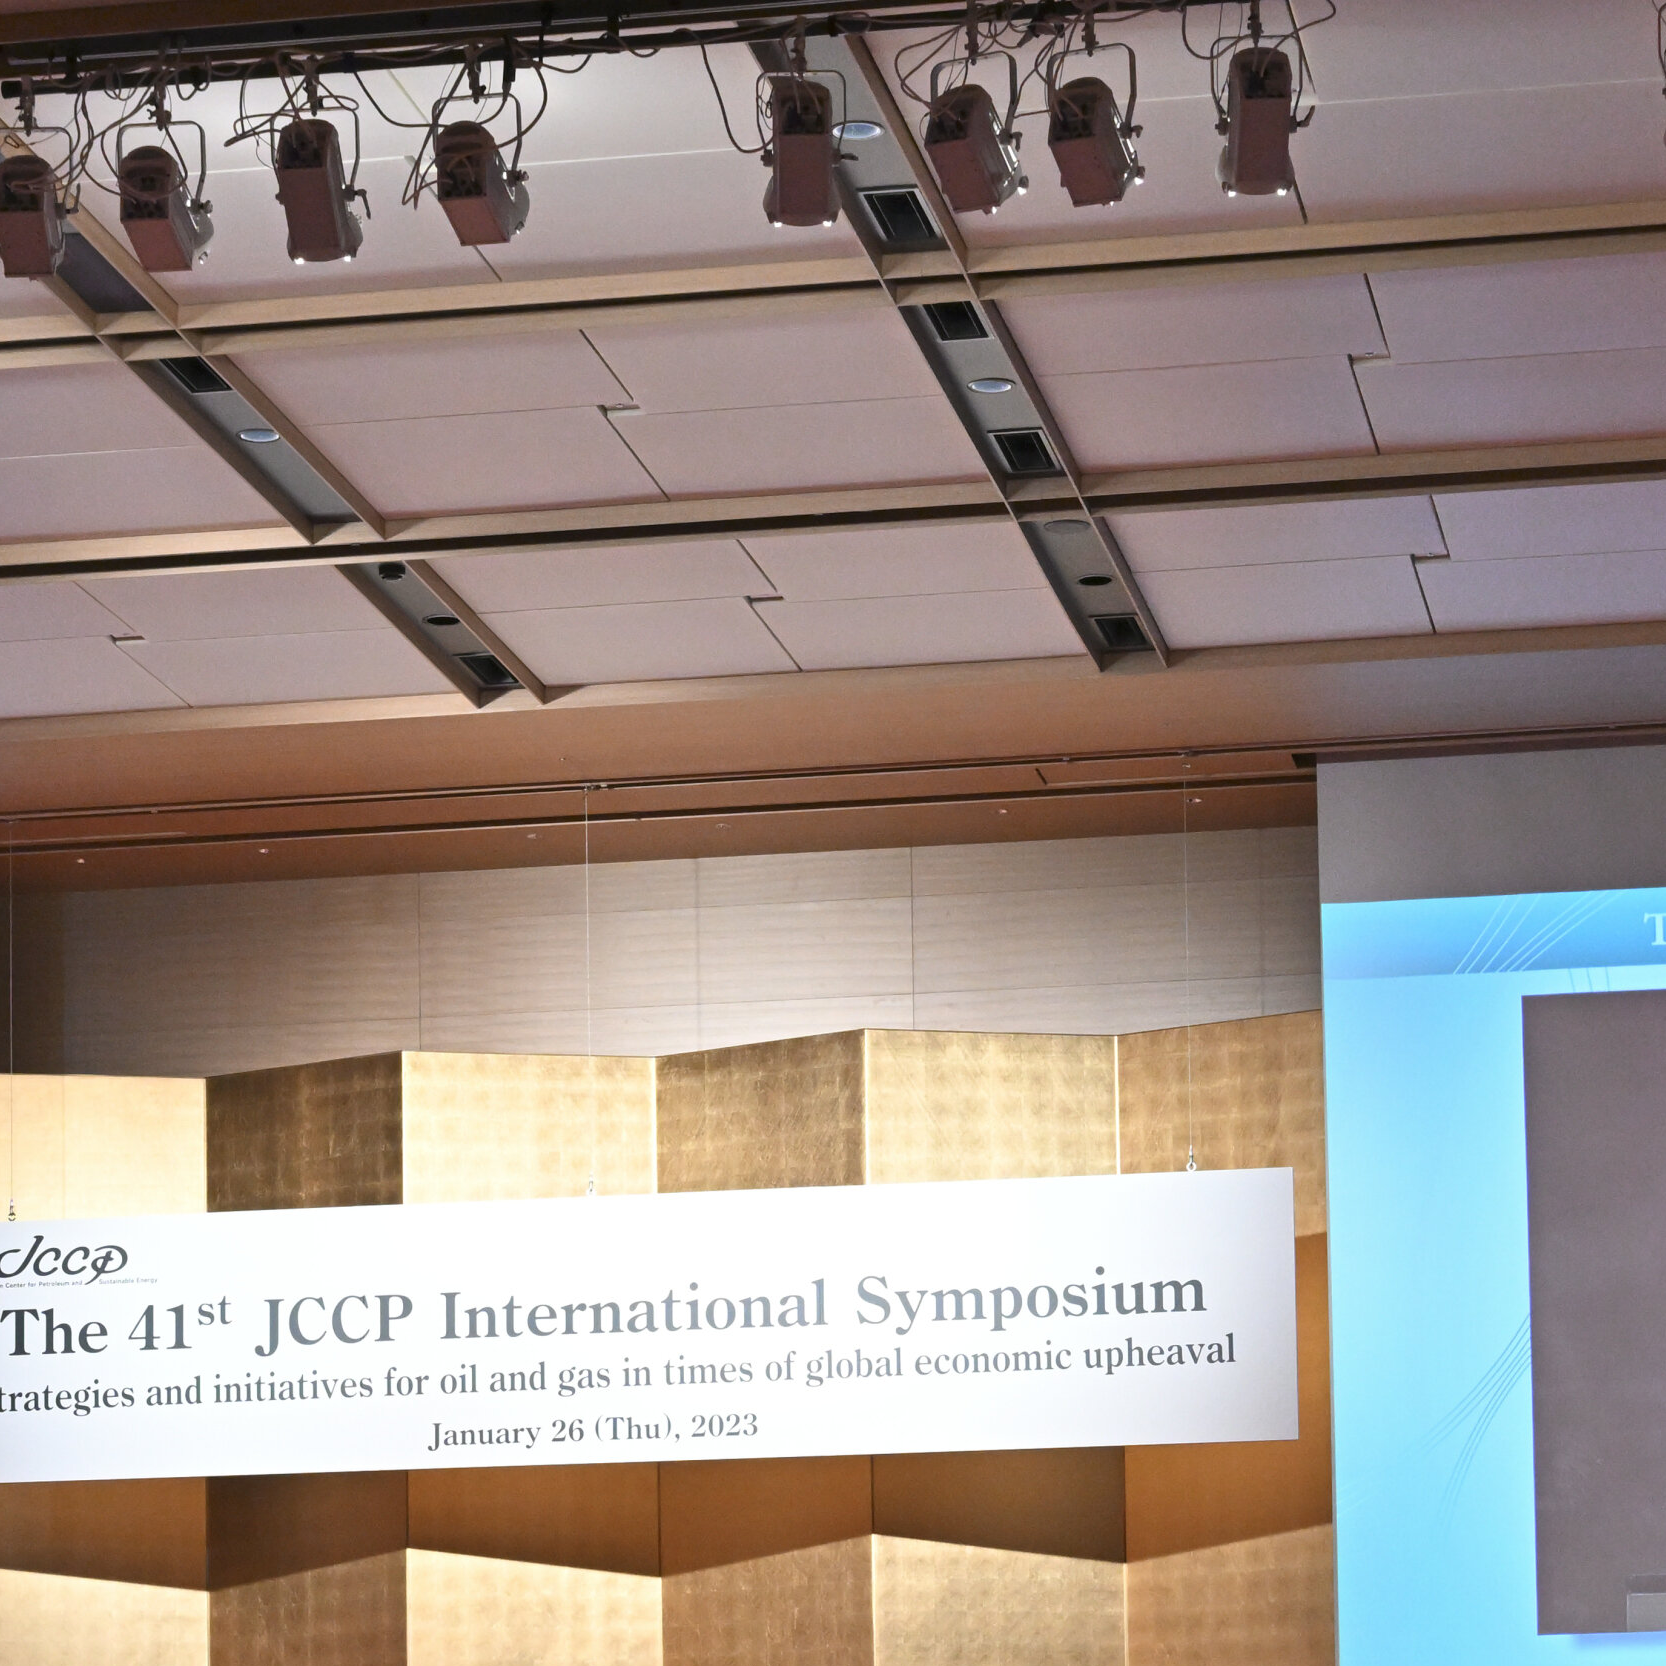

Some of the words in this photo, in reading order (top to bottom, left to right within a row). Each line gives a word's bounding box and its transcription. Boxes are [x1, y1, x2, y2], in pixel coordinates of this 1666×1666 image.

[99, 1277, 135, 1285] Sustainable
[136, 1277, 158, 1285] Energy
[0, 1308, 108, 1356] The
[128, 1296, 232, 1351] 41st
[254, 1295, 413, 1355] JCCP
[440, 1278, 828, 1339] International
[857, 1266, 1207, 1336] Symposium
[146, 1375, 202, 1406] and
[213, 1370, 373, 1403] initiatives
[384, 1367, 429, 1396] for
[440, 1364, 479, 1394] oil
[490, 1361, 547, 1392] and
[558, 1366, 610, 1397] gas
[622, 1357, 652, 1386] in
[664, 1355, 753, 1385] times
[766, 1351, 796, 1381] of
[806, 1347, 903, 1387] global
[915, 1340, 1072, 1375] economic
[1083, 1332, 1236, 1375] upheaval
[428, 1423, 541, 1451] January
[551, 1419, 584, 1442] 26
[595, 1415, 680, 1443] (Thu),
[691, 1413, 758, 1437] 2023
